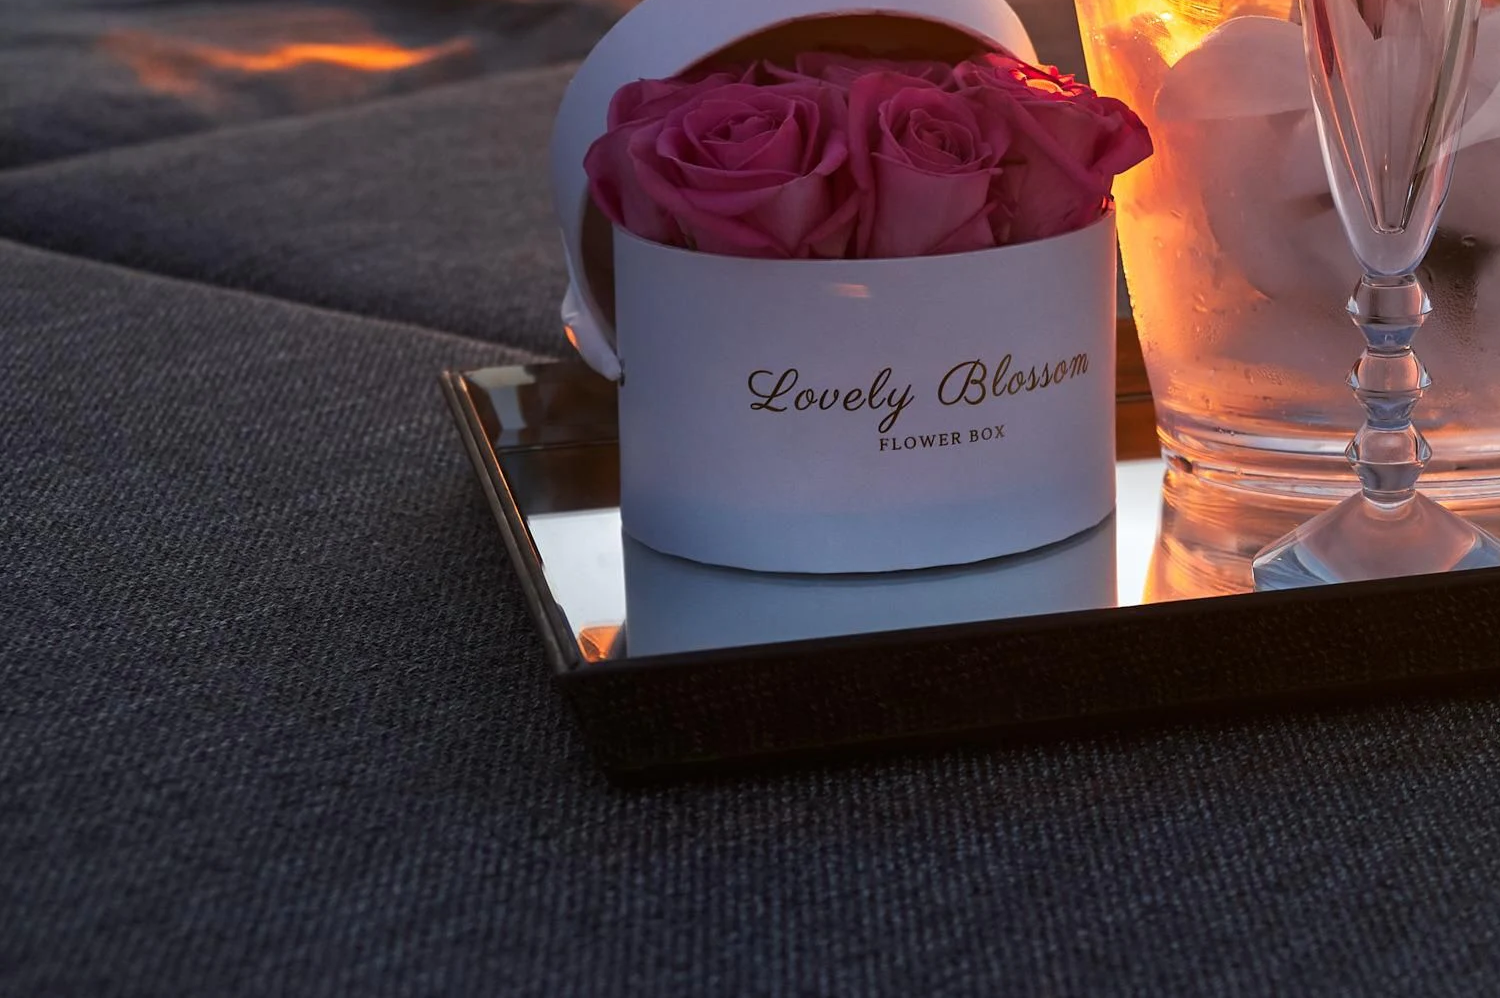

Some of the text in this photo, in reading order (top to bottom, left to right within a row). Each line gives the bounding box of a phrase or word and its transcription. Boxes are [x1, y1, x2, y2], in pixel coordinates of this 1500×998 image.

[747, 352, 1089, 434] Lovely Blossom
[879, 424, 1006, 452] FLOWER BOX
